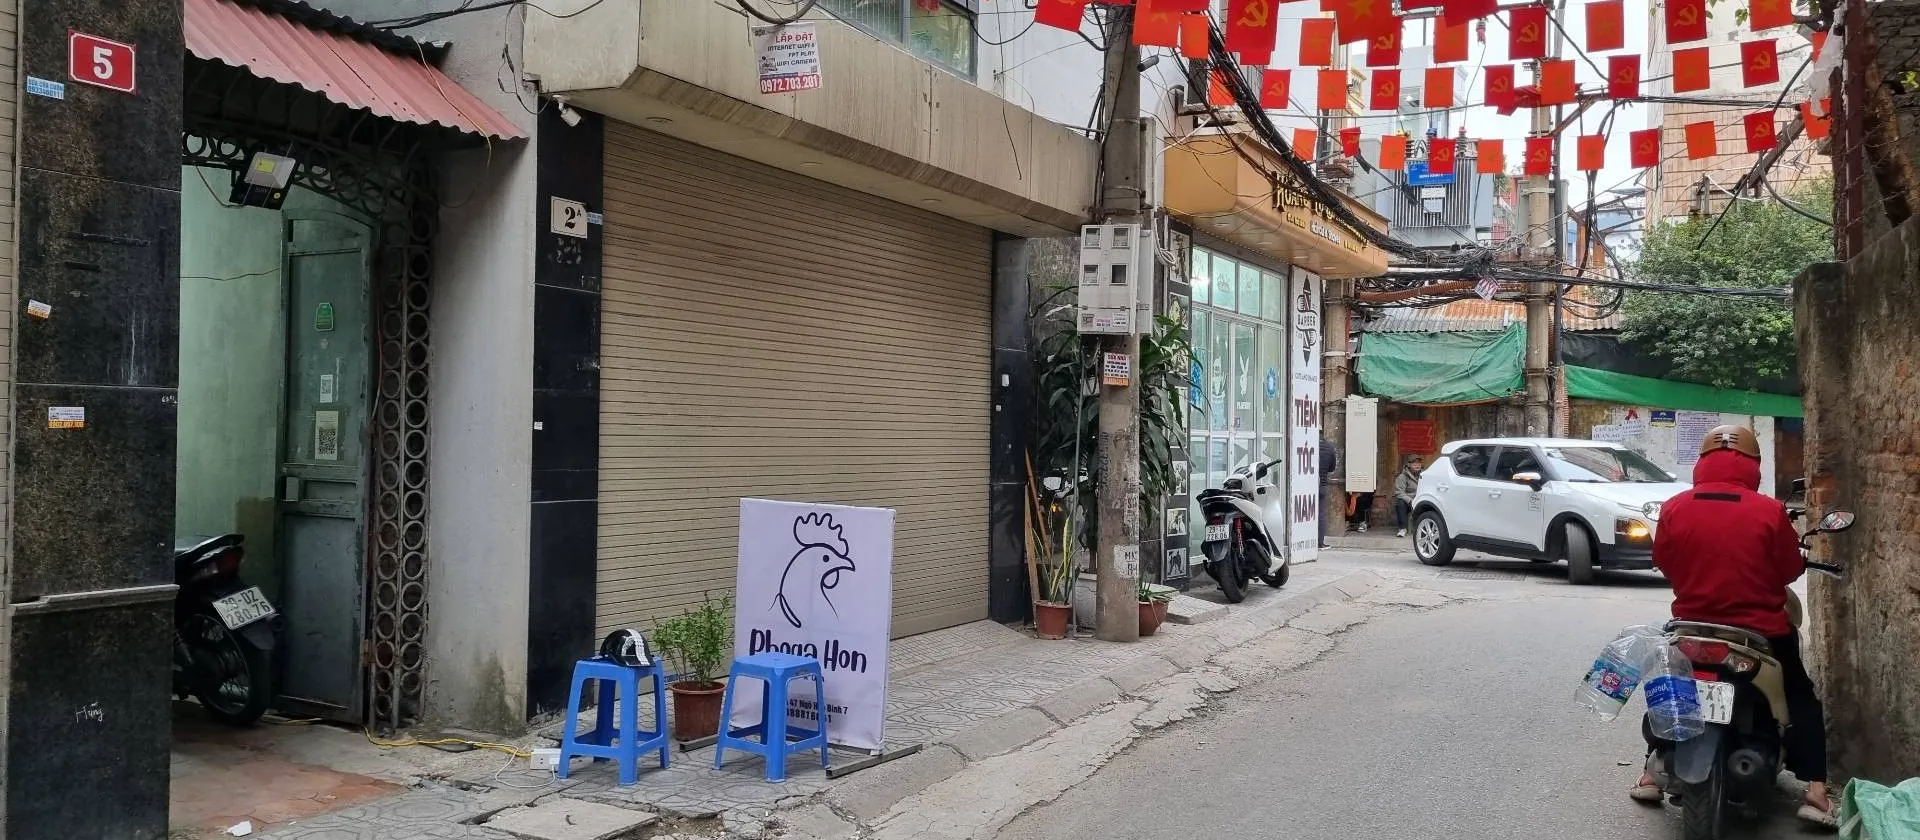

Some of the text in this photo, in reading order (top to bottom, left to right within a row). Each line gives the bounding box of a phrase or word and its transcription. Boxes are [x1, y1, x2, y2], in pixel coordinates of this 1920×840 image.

[776, 32, 813, 43] LẮP ĐẶT
[94, 46, 113, 79] 5
[761, 75, 818, 92] 0972.703.201
[1295, 393, 1317, 434] TIỆM
[1297, 441, 1314, 475] TÓC
[1294, 494, 1316, 523] NAM
[824, 640, 867, 673] Hon
[843, 706, 848, 715] 7
